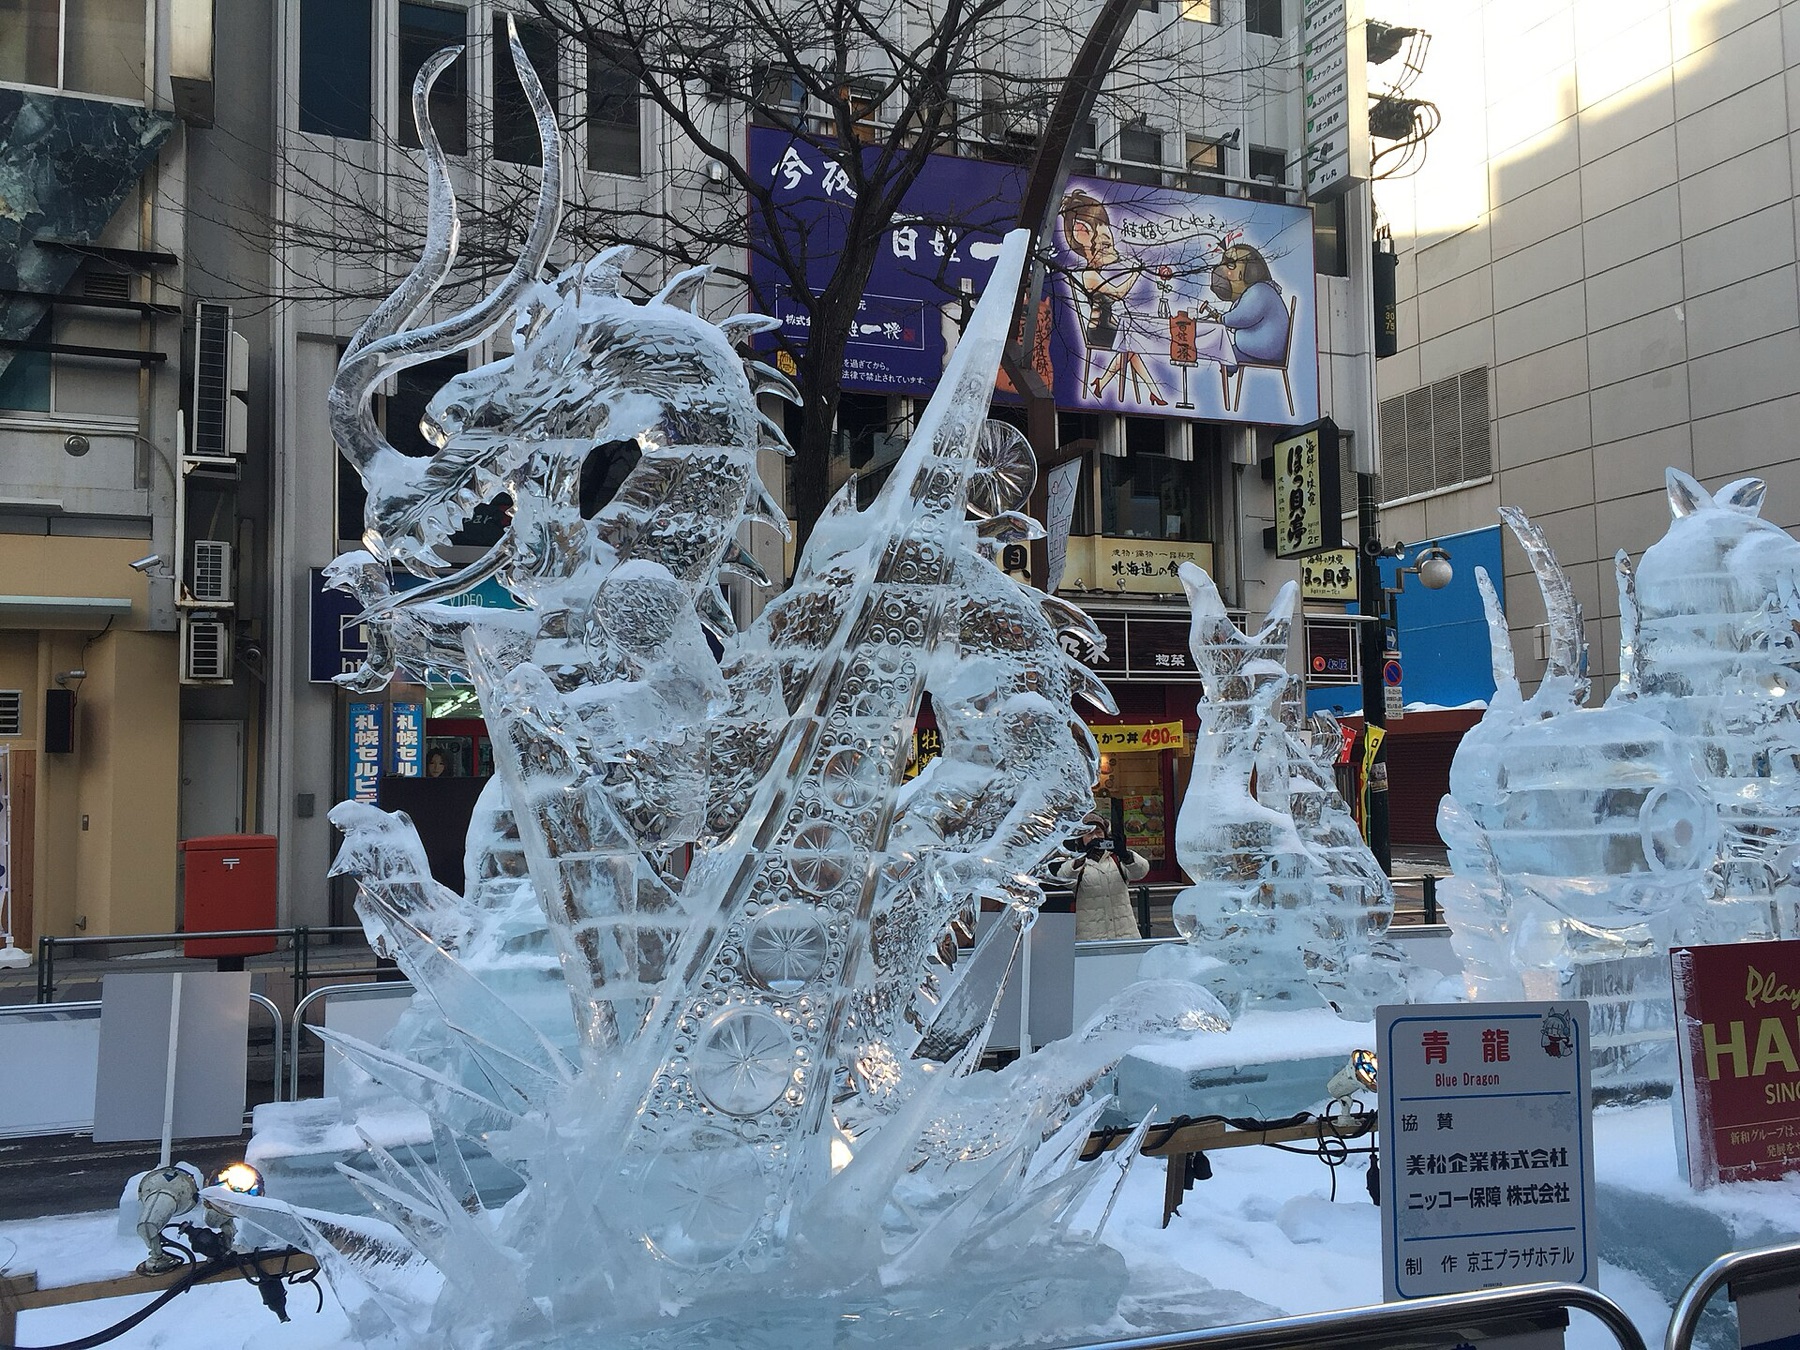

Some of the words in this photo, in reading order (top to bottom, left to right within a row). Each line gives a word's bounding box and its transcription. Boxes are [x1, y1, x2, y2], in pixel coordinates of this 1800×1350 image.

[1320, 168, 1338, 184] すし丸
[1286, 444, 1308, 550] ほっ貝亭
[1307, 535, 1320, 546] 2F
[1155, 654, 1186, 667] 惣菜
[1434, 1073, 1459, 1088] Blue
[1463, 1072, 1501, 1087] Dragon
[1405, 1147, 1570, 1176] 美松企業株式会社
[1466, 1246, 1576, 1272] 京王プラザホテル
